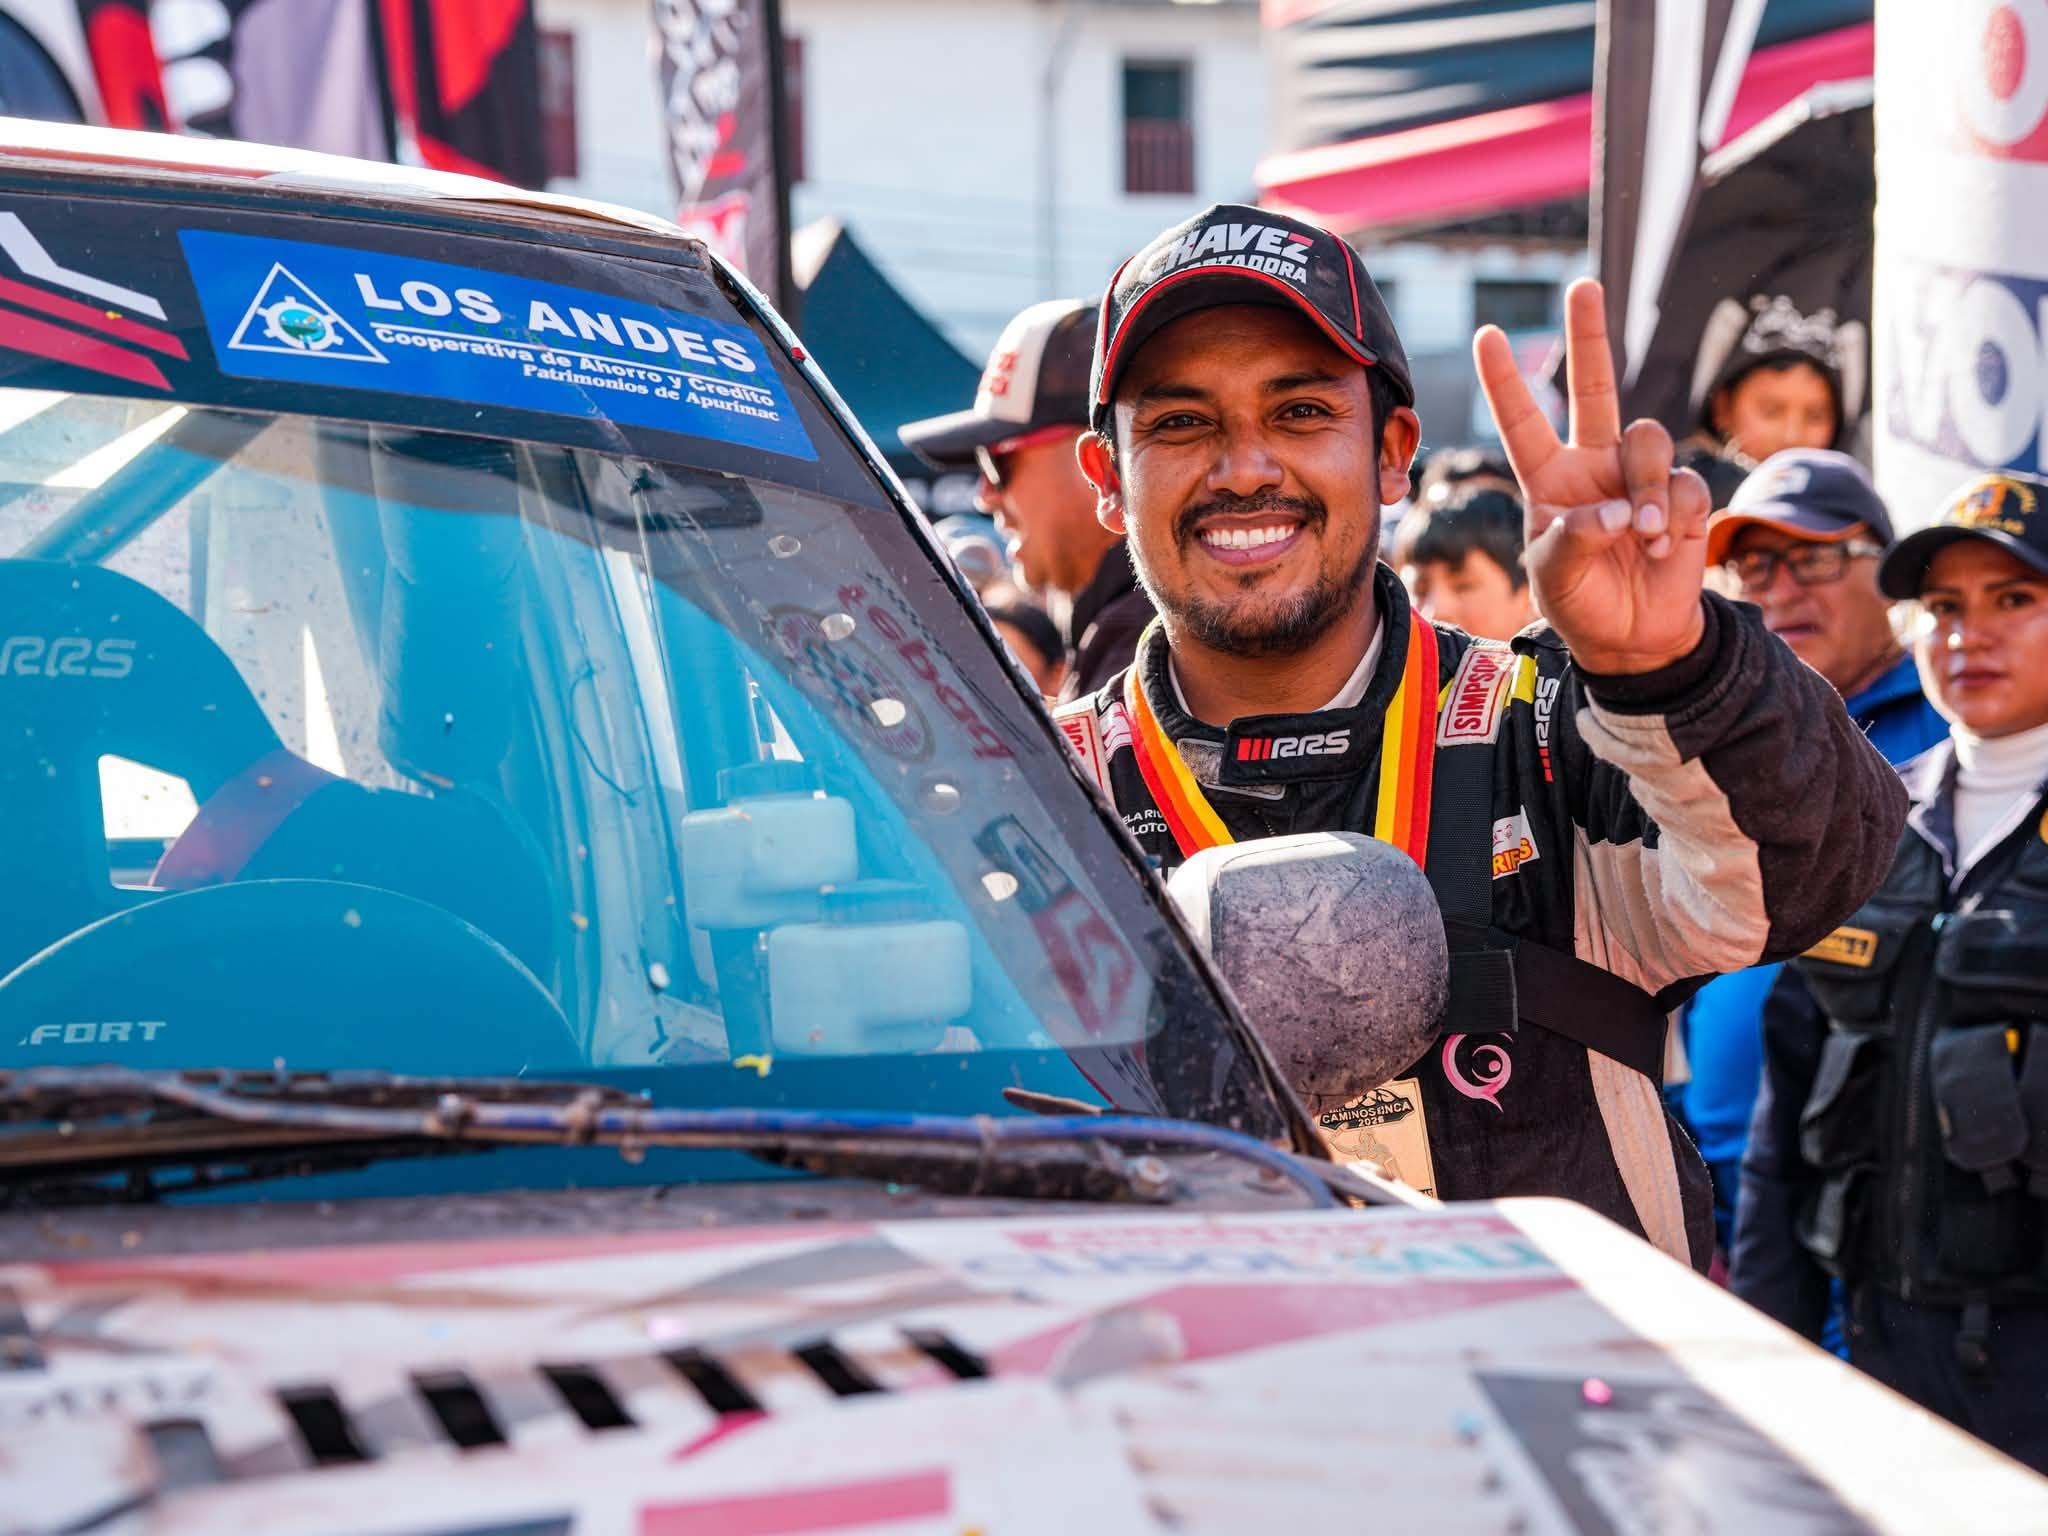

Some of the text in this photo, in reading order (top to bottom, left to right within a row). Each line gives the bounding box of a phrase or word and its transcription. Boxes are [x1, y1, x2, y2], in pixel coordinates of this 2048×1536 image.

[354, 273, 756, 373] LOS ANDES
[375, 328, 534, 362] Cooperativa
[540, 350, 572, 368] de
[580, 357, 662, 383] Ahorro
[668, 374, 682, 390] y
[523, 364, 649, 395] Patrimonios
[654, 386, 680, 401] de
[0, 636, 137, 679] RRS
[1534, 675, 1560, 748] RRS
[1270, 728, 1351, 759] RRS
[1321, 1106, 1378, 1125] CAMINOS
